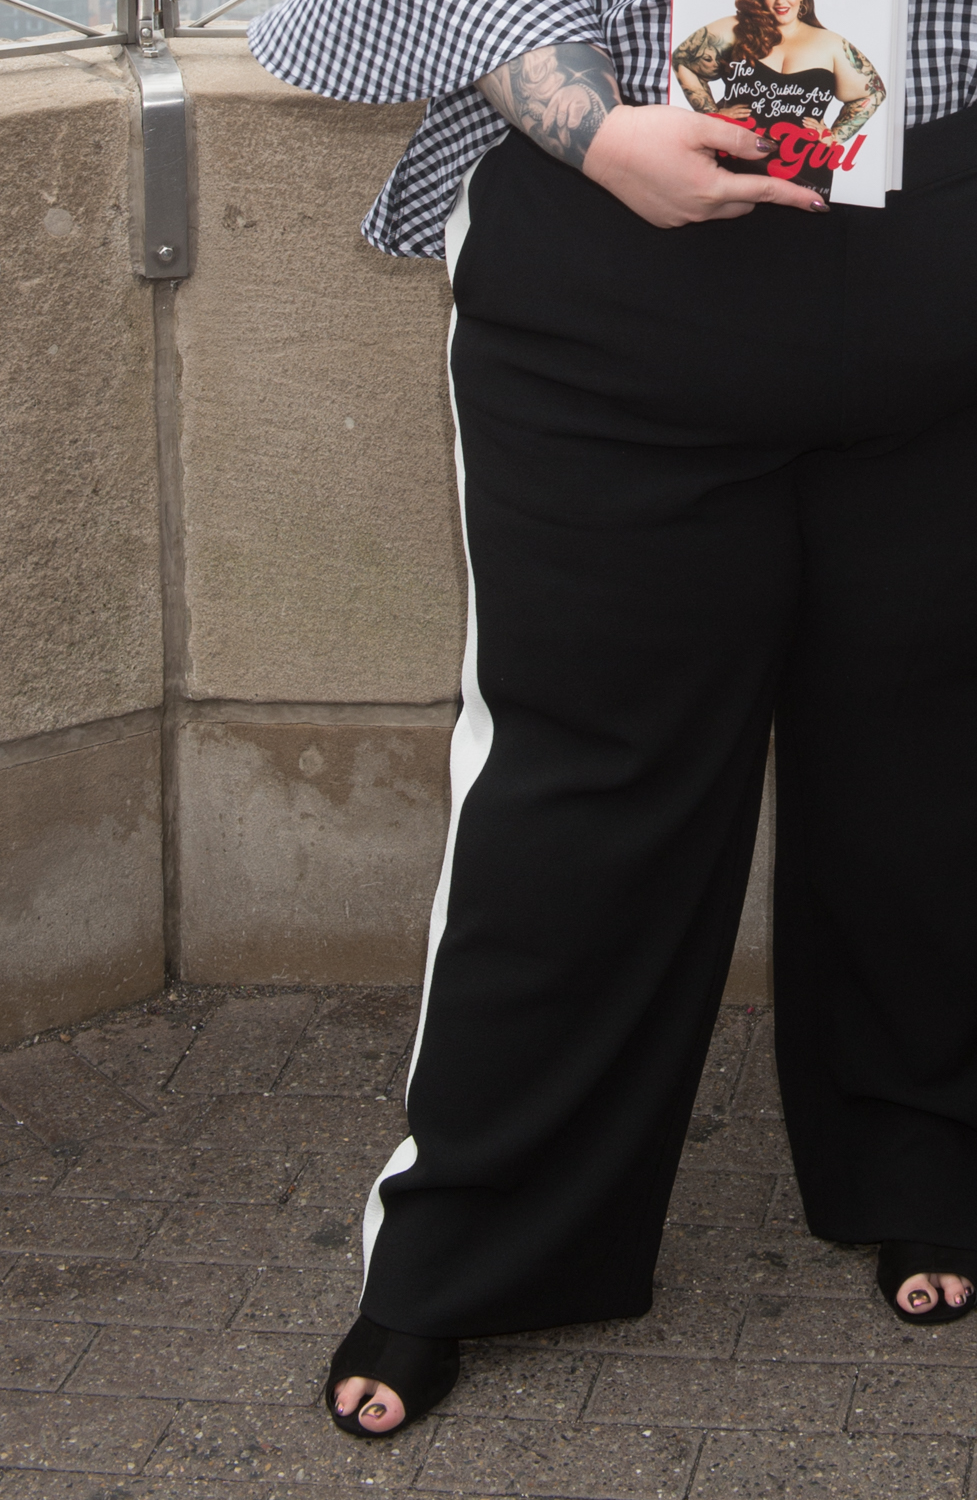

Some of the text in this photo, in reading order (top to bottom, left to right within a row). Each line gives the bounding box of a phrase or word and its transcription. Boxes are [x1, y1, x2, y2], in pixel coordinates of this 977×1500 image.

[727, 59, 754, 81] The
[724, 80, 833, 104] Not So Subtle Art
[751, 98, 823, 118] of Being a
[767, 121, 868, 181] Girl
